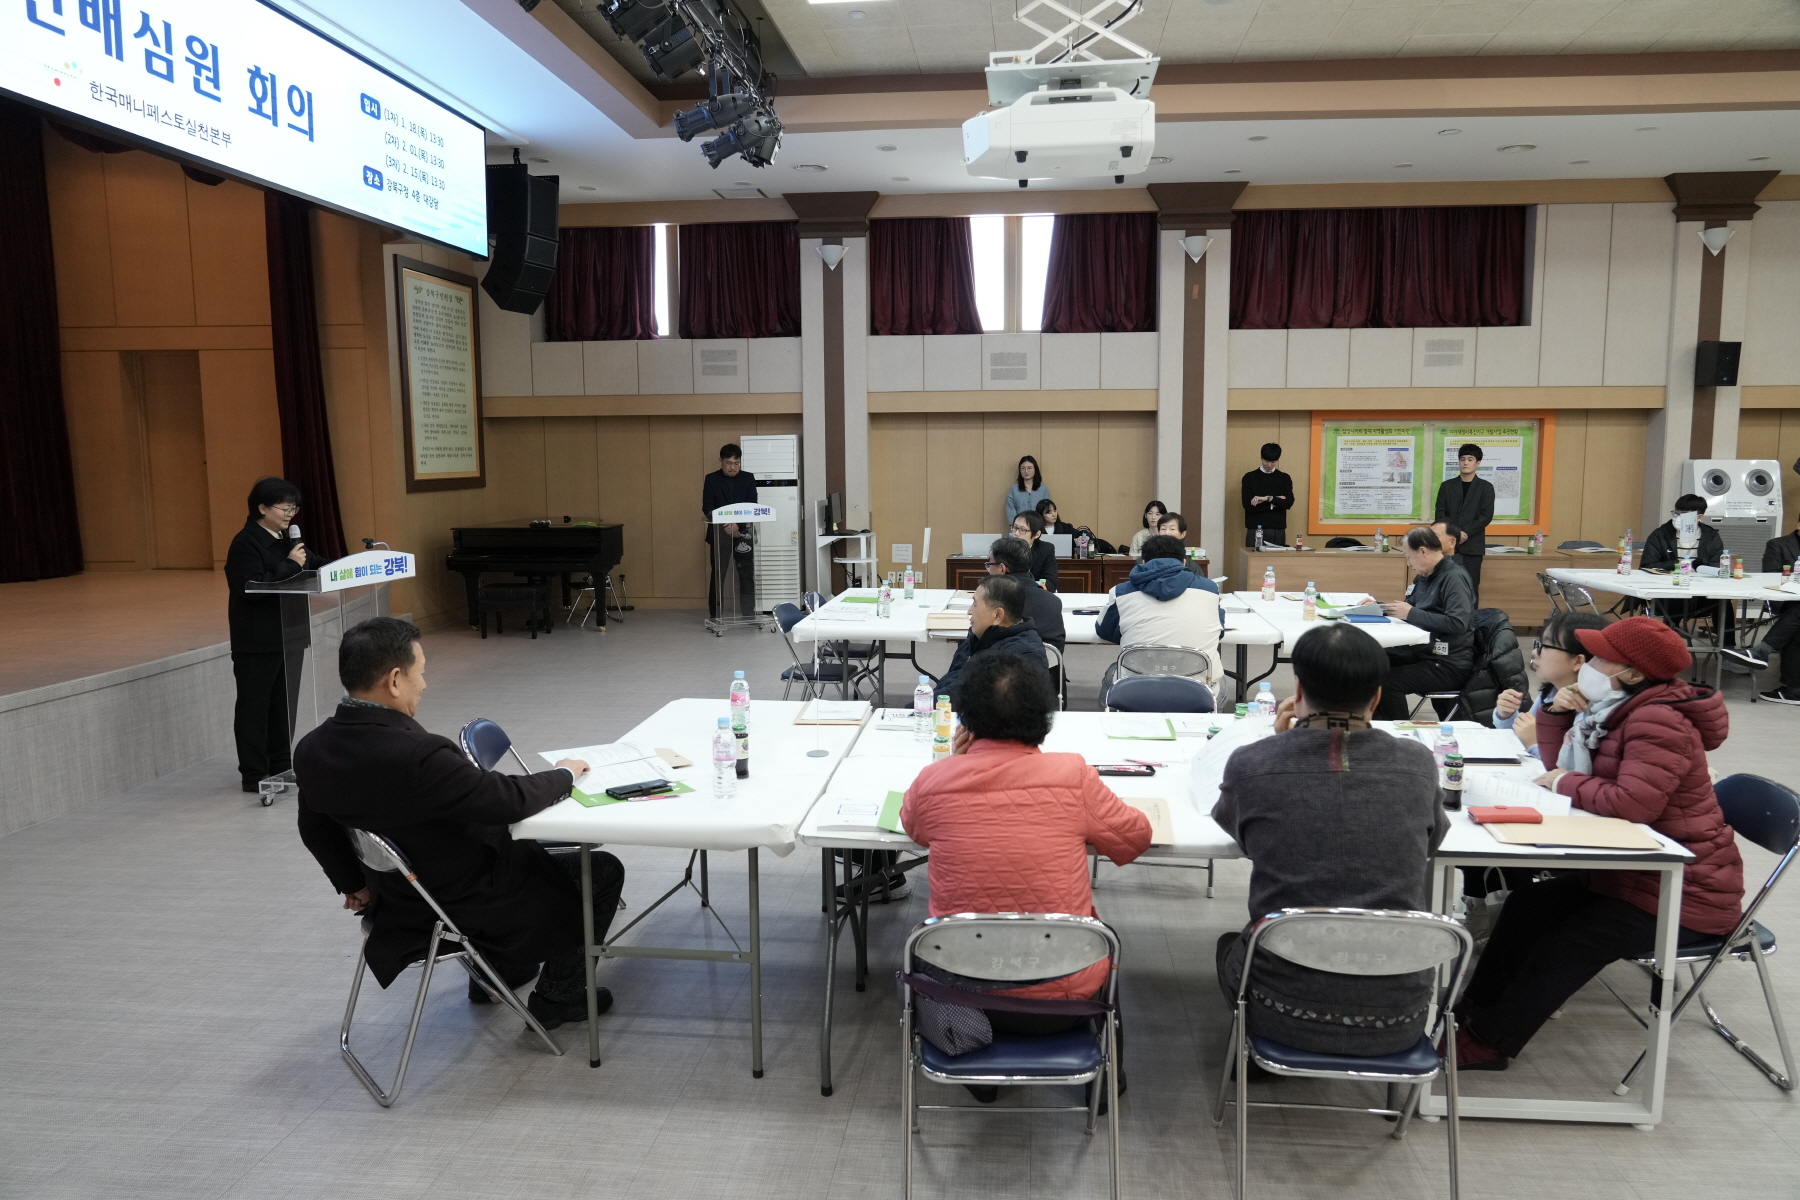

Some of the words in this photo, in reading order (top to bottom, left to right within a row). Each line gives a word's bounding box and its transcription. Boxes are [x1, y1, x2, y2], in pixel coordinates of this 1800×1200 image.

[89, 81, 233, 148] 한국매니페스토실천본부
[246, 64, 315, 143] 회의
[384, 108, 399, 126] (1차)
[384, 132, 400, 150] (2차)
[385, 155, 401, 172] (3차)
[330, 570, 338, 582] 내
[339, 568, 354, 581] 삶에
[354, 565, 368, 579] 힘이
[369, 563, 383, 576] 되는
[383, 555, 408, 576] 강북!
